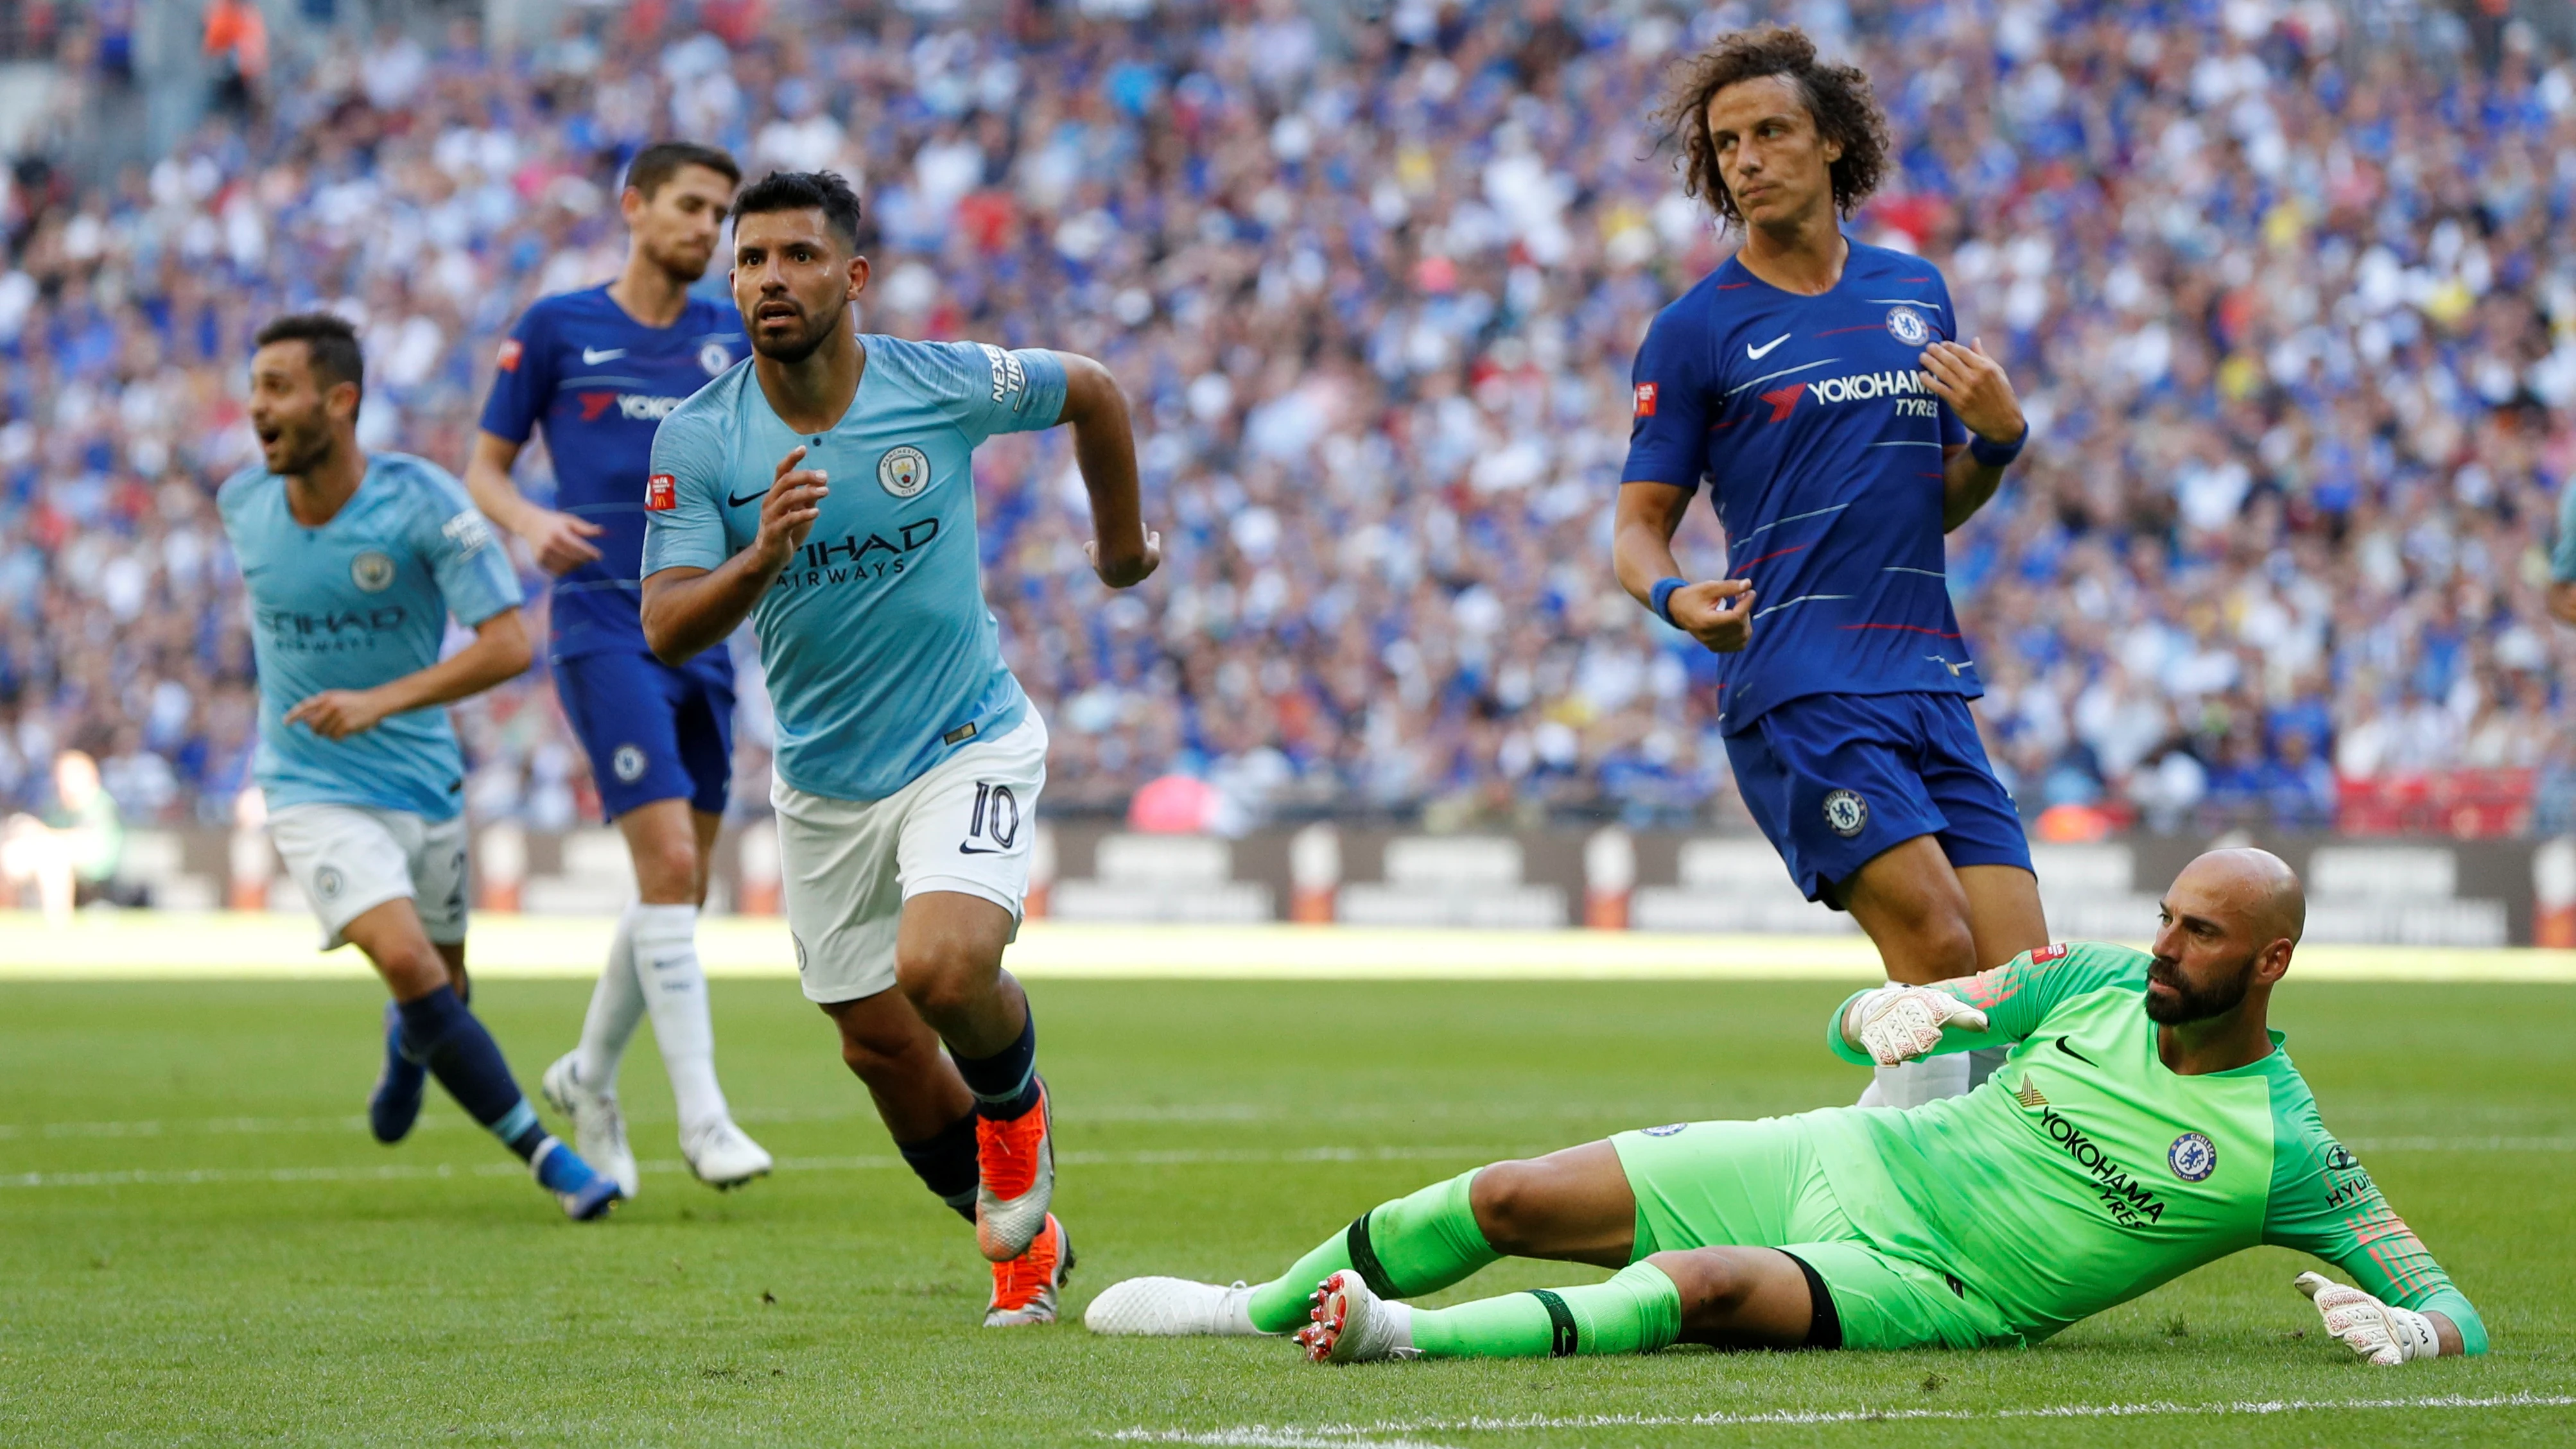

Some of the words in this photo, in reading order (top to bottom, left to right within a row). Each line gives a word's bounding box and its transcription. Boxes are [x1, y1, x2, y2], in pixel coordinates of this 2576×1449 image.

[1807, 369, 1938, 406] YOKOHAM
[616, 393, 685, 420] YOKO
[1895, 398, 1938, 418] TYRES
[882, 449, 922, 468] MANCHESTER
[783, 517, 939, 571] IHAD
[776, 558, 905, 589] AIRWAYS
[969, 781, 1019, 849] 10
[2190, 1133, 2215, 1158] CHELSEA
[2041, 1105, 2166, 1225] YOKOHAMA
